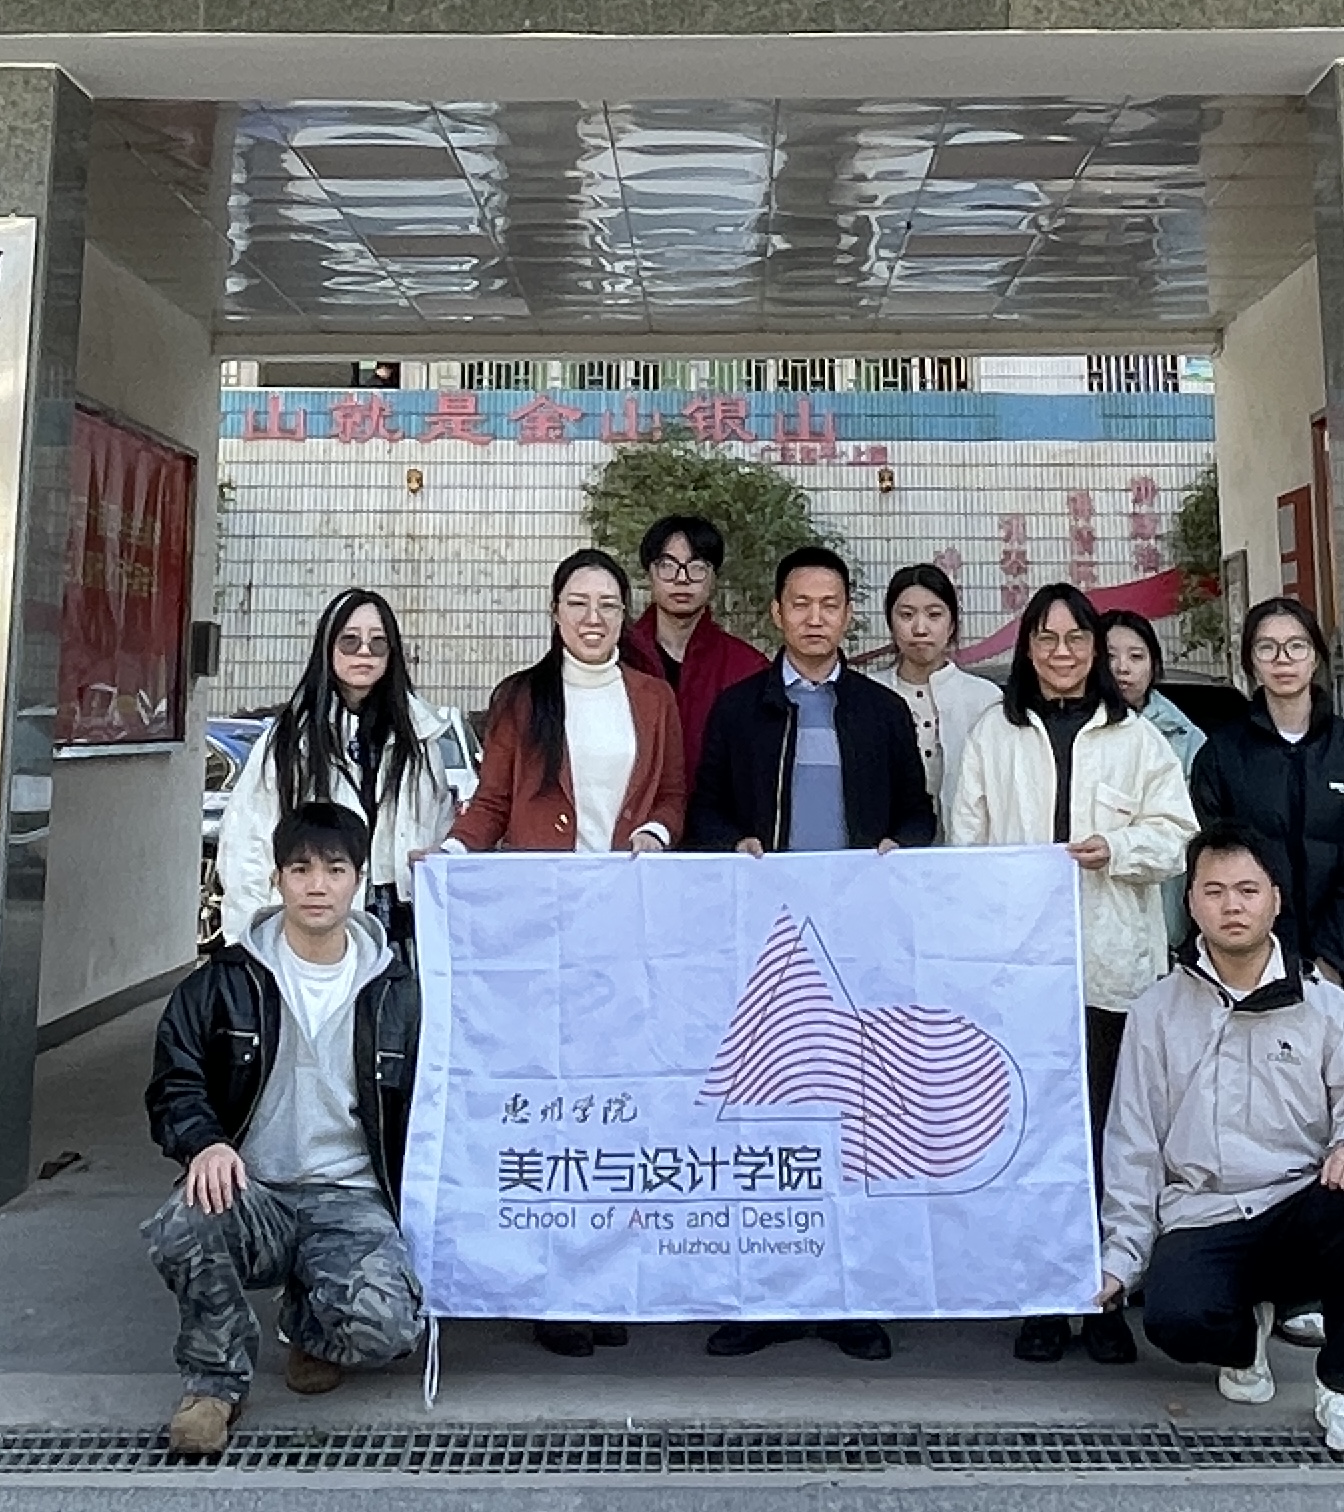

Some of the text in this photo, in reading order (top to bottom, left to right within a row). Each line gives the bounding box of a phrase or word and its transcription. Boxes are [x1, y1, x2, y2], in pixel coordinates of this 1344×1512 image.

[242, 388, 836, 447] 山就是金山银山
[500, 1091, 638, 1125] 惠州学院
[498, 1144, 823, 1194] 美术与设计学院
[498, 1205, 825, 1233] School of Arts and Design
[658, 1237, 826, 1258] Huizhou University
